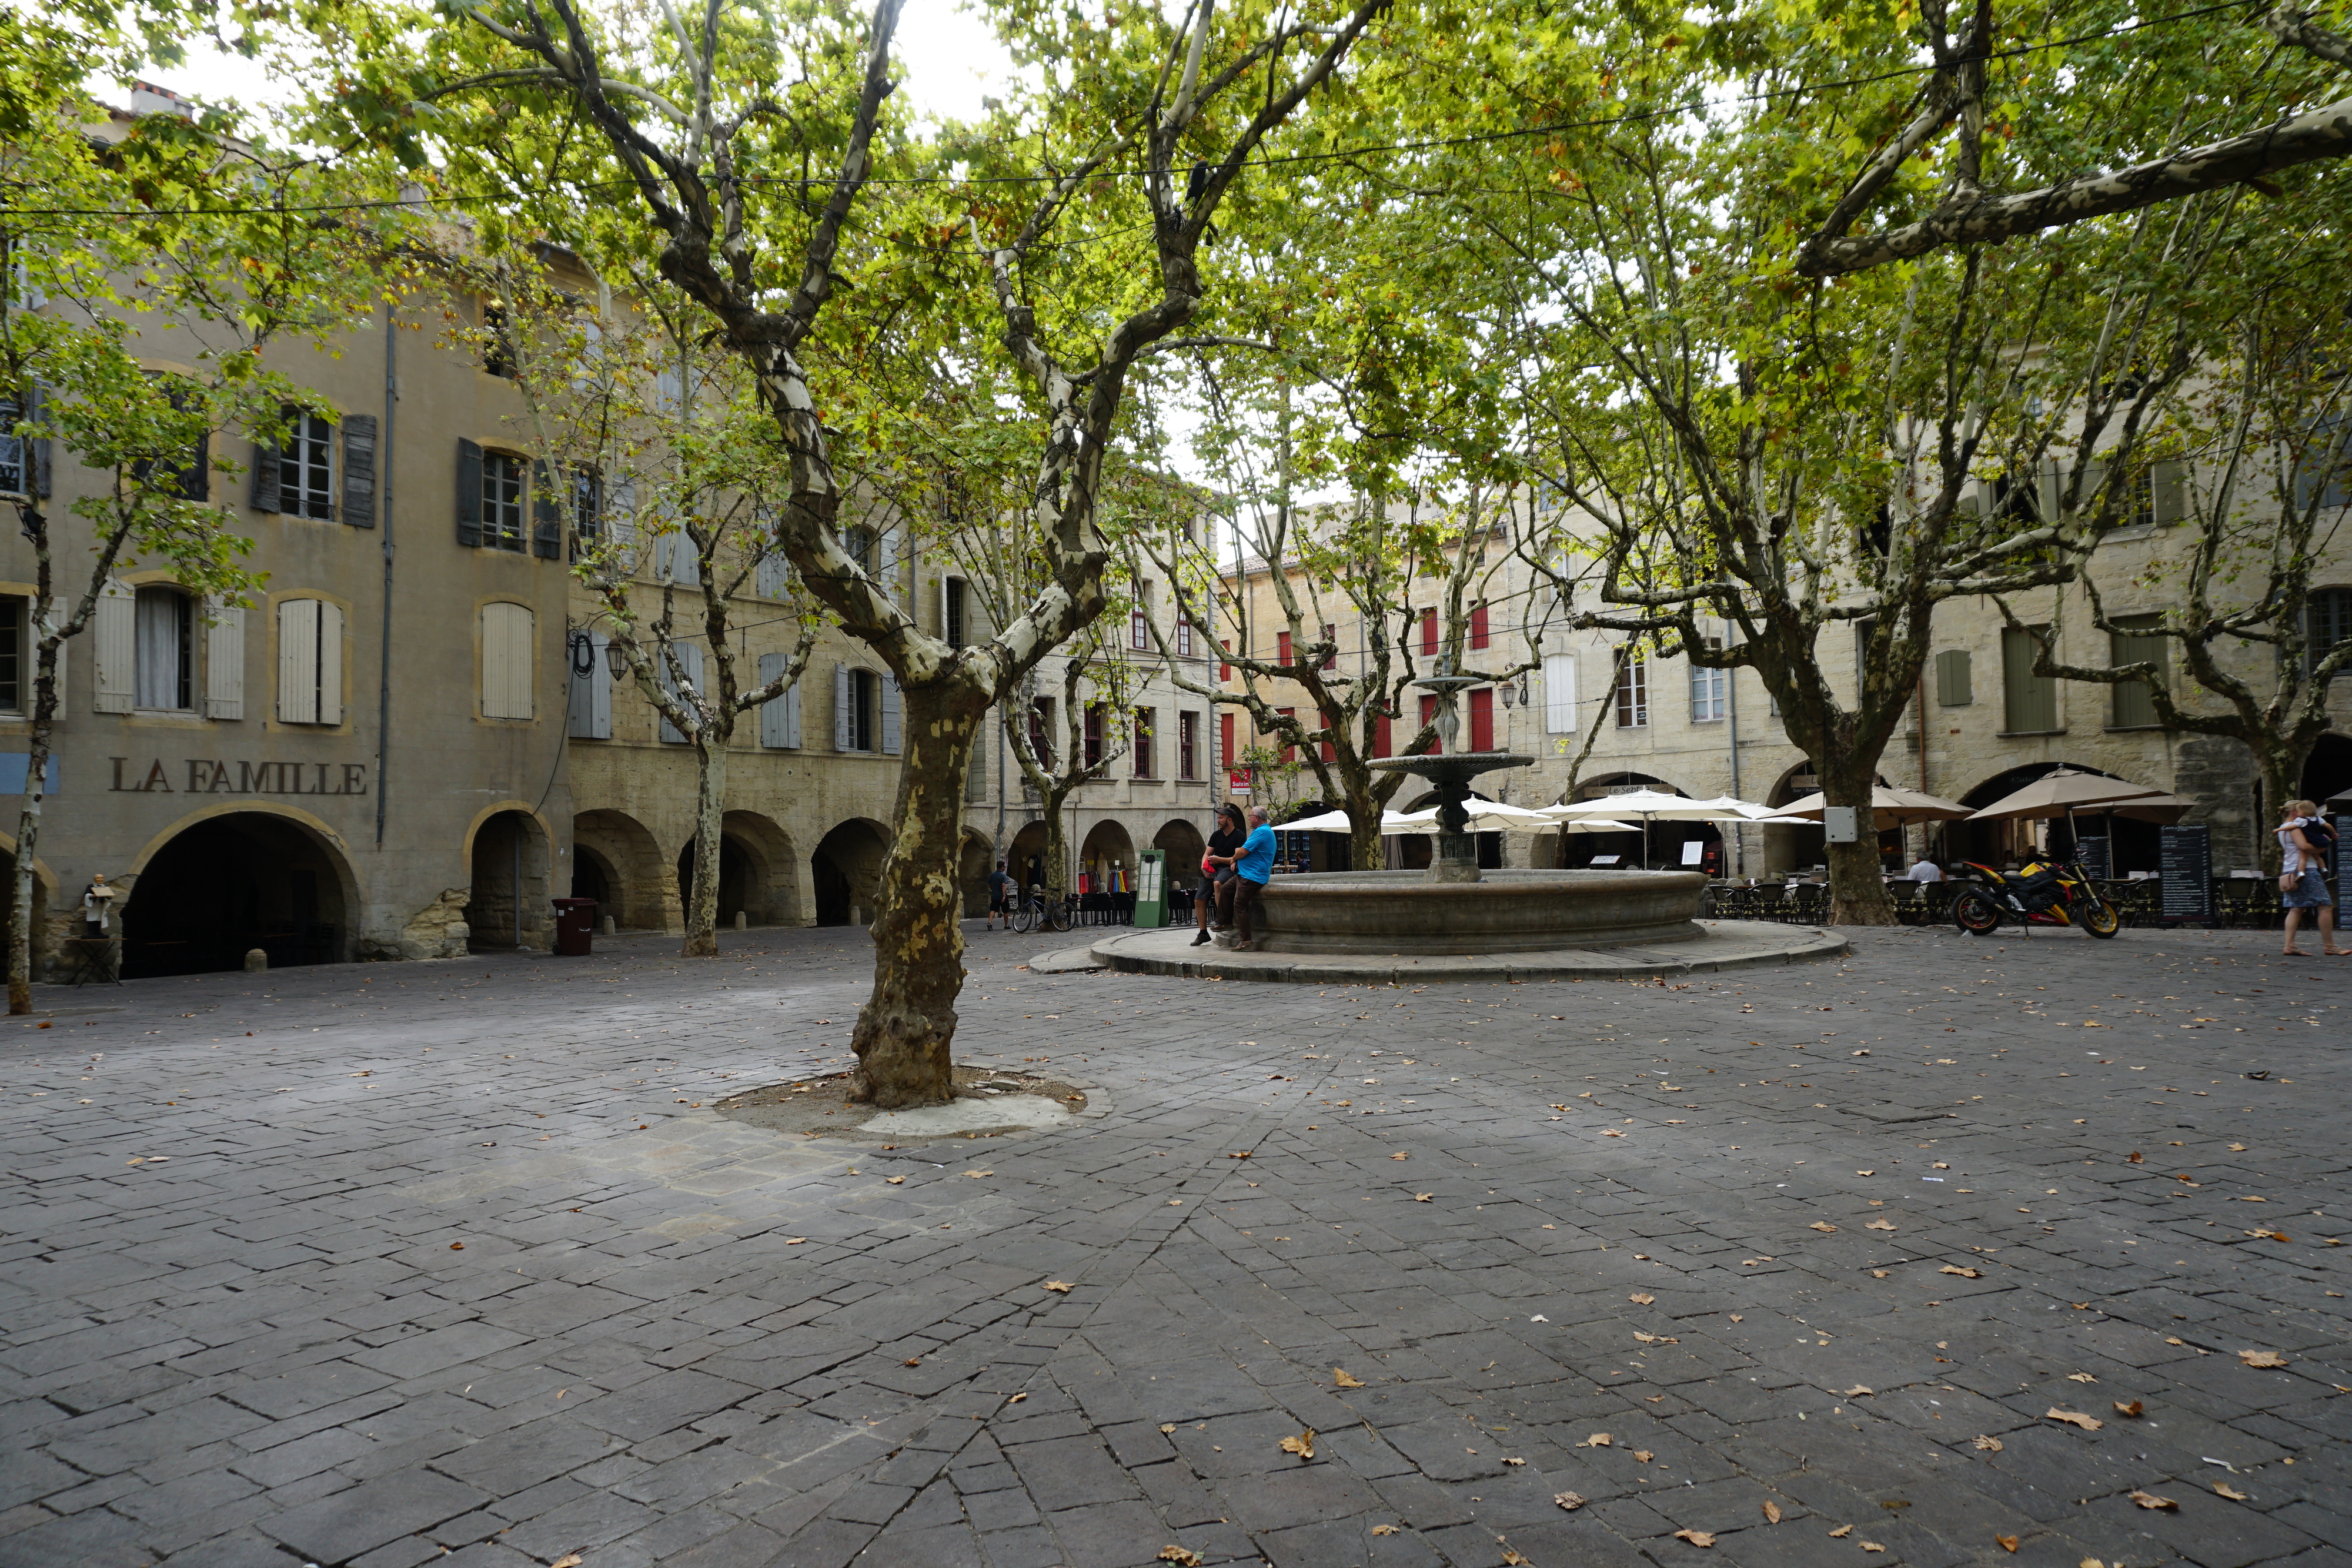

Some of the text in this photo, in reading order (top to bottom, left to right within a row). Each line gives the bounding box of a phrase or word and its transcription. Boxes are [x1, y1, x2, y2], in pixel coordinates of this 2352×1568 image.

[108, 757, 366, 795] LA FAMILLE
[1621, 785, 1641, 794] Sept
